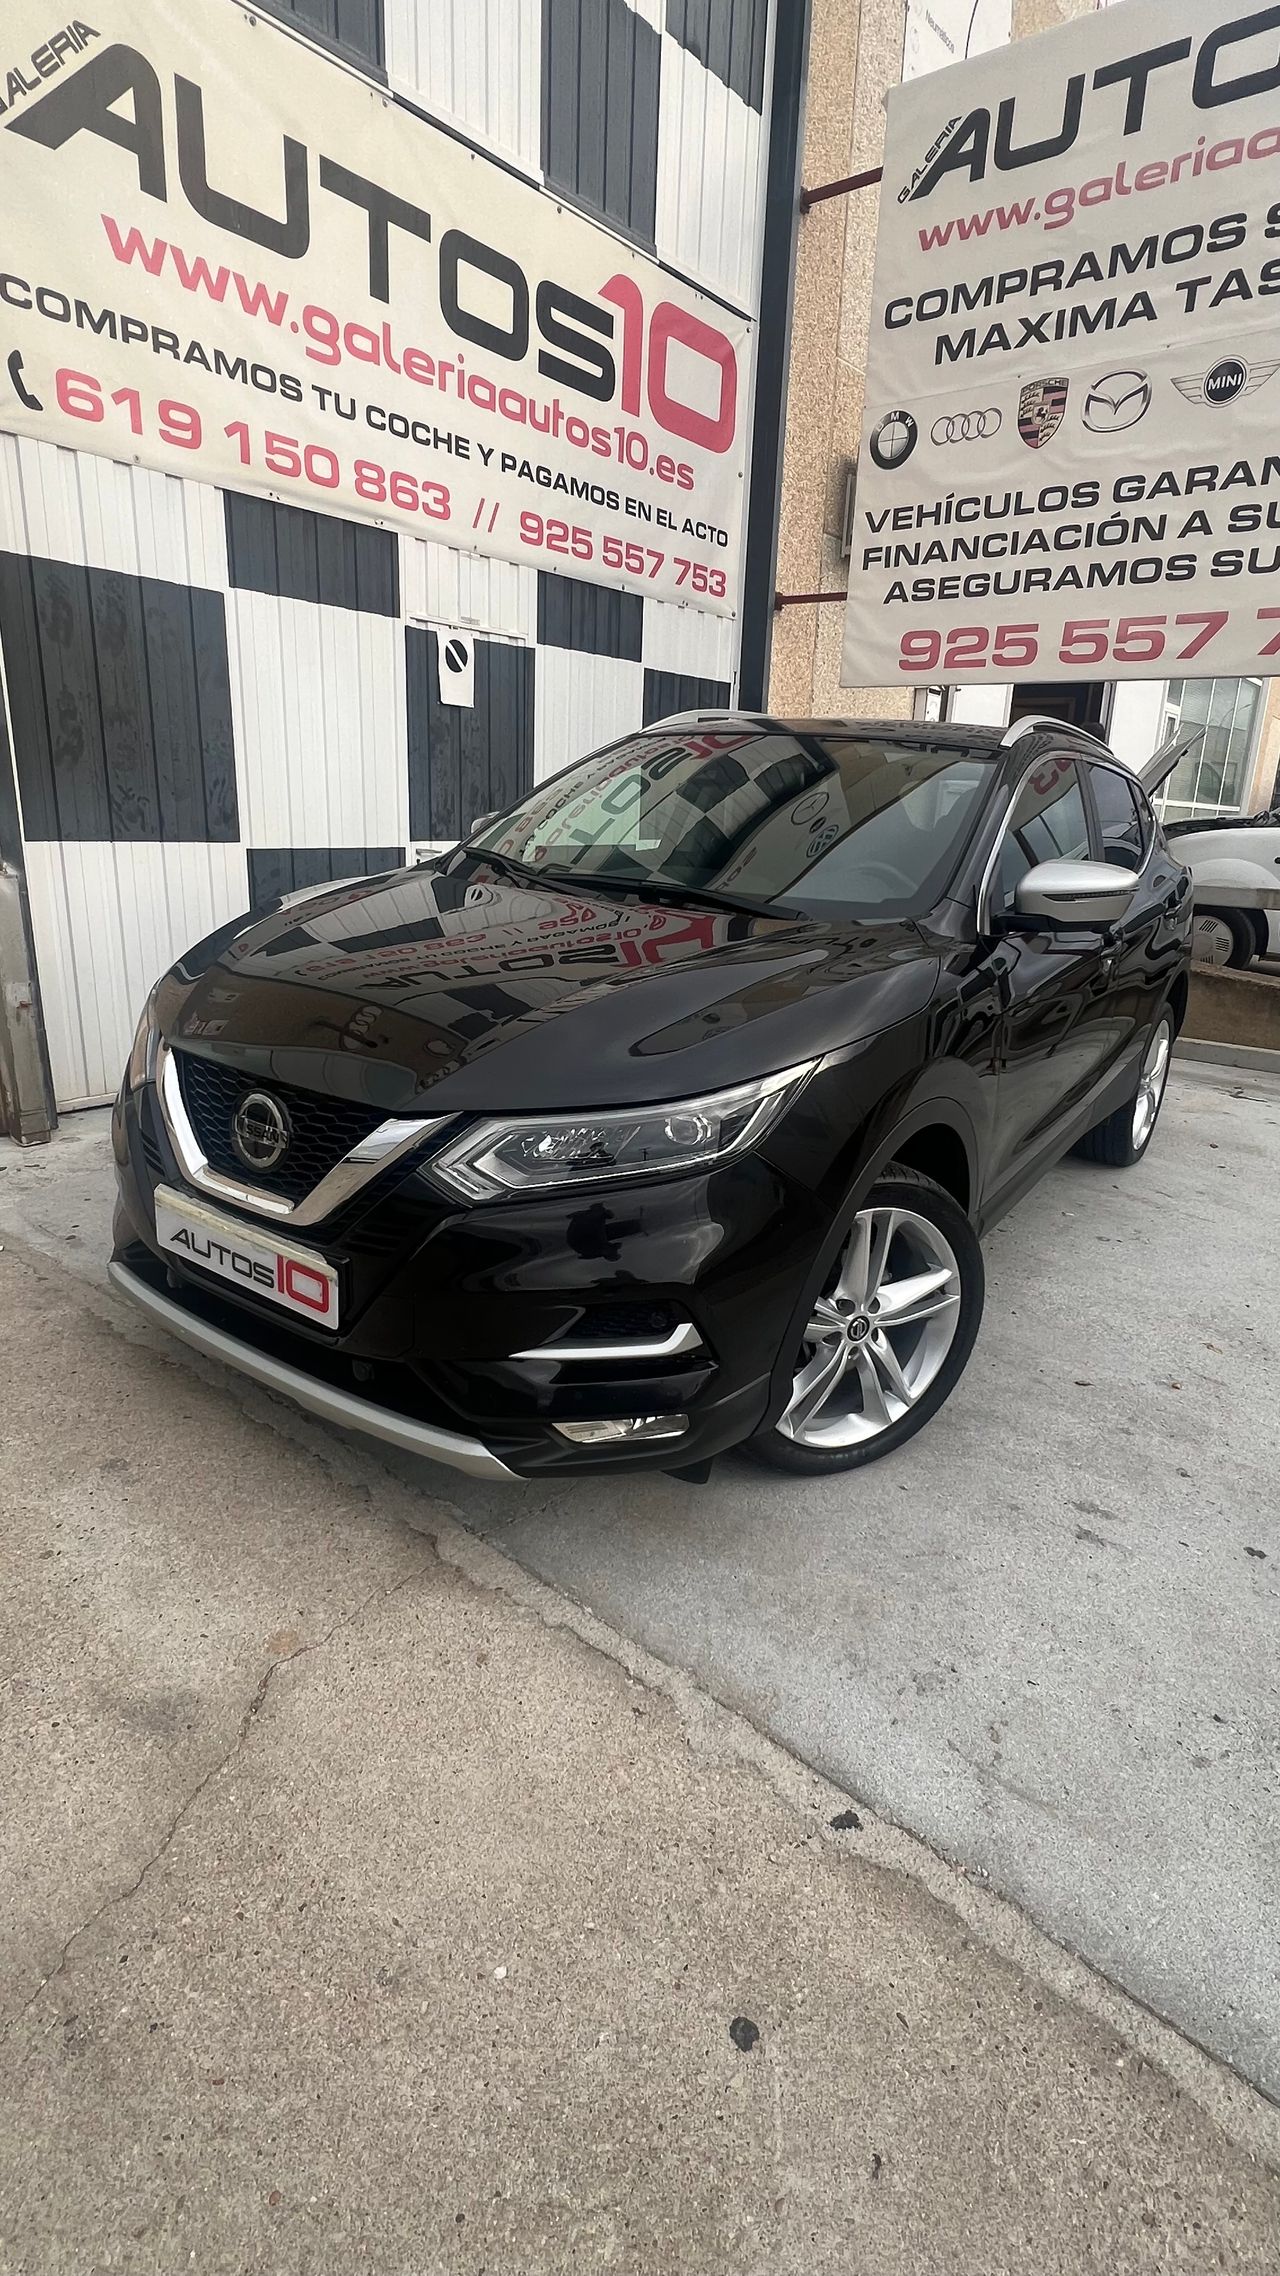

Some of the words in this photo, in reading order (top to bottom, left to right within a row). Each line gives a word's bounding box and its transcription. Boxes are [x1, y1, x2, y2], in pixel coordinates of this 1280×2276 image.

[908, 4, 1280, 202] AUTO
[897, 116, 962, 204] GALERIA
[4, 43, 738, 454] AUTOS10
[884, 213, 1247, 330] COMPRAMOS
[101, 213, 695, 491] www.galeriaautos10.es
[935, 291, 1157, 366] MAXIMA
[0, 273, 303, 402] COMPRAMOS
[312, 384, 356, 421] TU
[366, 404, 470, 459] COCHE
[477, 443, 494, 467] Y
[501, 453, 620, 511] PAGAMOS
[625, 499, 652, 522] EN
[656, 509, 678, 531] EL
[682, 519, 729, 548] ACTO
[1208, 373, 1242, 392] MINI
[55, 368, 202, 450] 619
[224, 421, 340, 488] 150
[354, 459, 451, 521] 863
[520, 511, 594, 561] 925
[603, 535, 665, 579] 557
[673, 558, 727, 598] 753
[865, 481, 1100, 533] VEHÍCULOS
[862, 511, 1166, 571] FINANCIACIÓN
[1177, 510, 1213, 539] A
[883, 553, 1197, 604] ASEGURAMOS
[1210, 546, 1280, 577] SU
[899, 623, 1039, 671] 925
[1058, 611, 1229, 664] 557
[170, 1228, 329, 1313] AUTOS10
